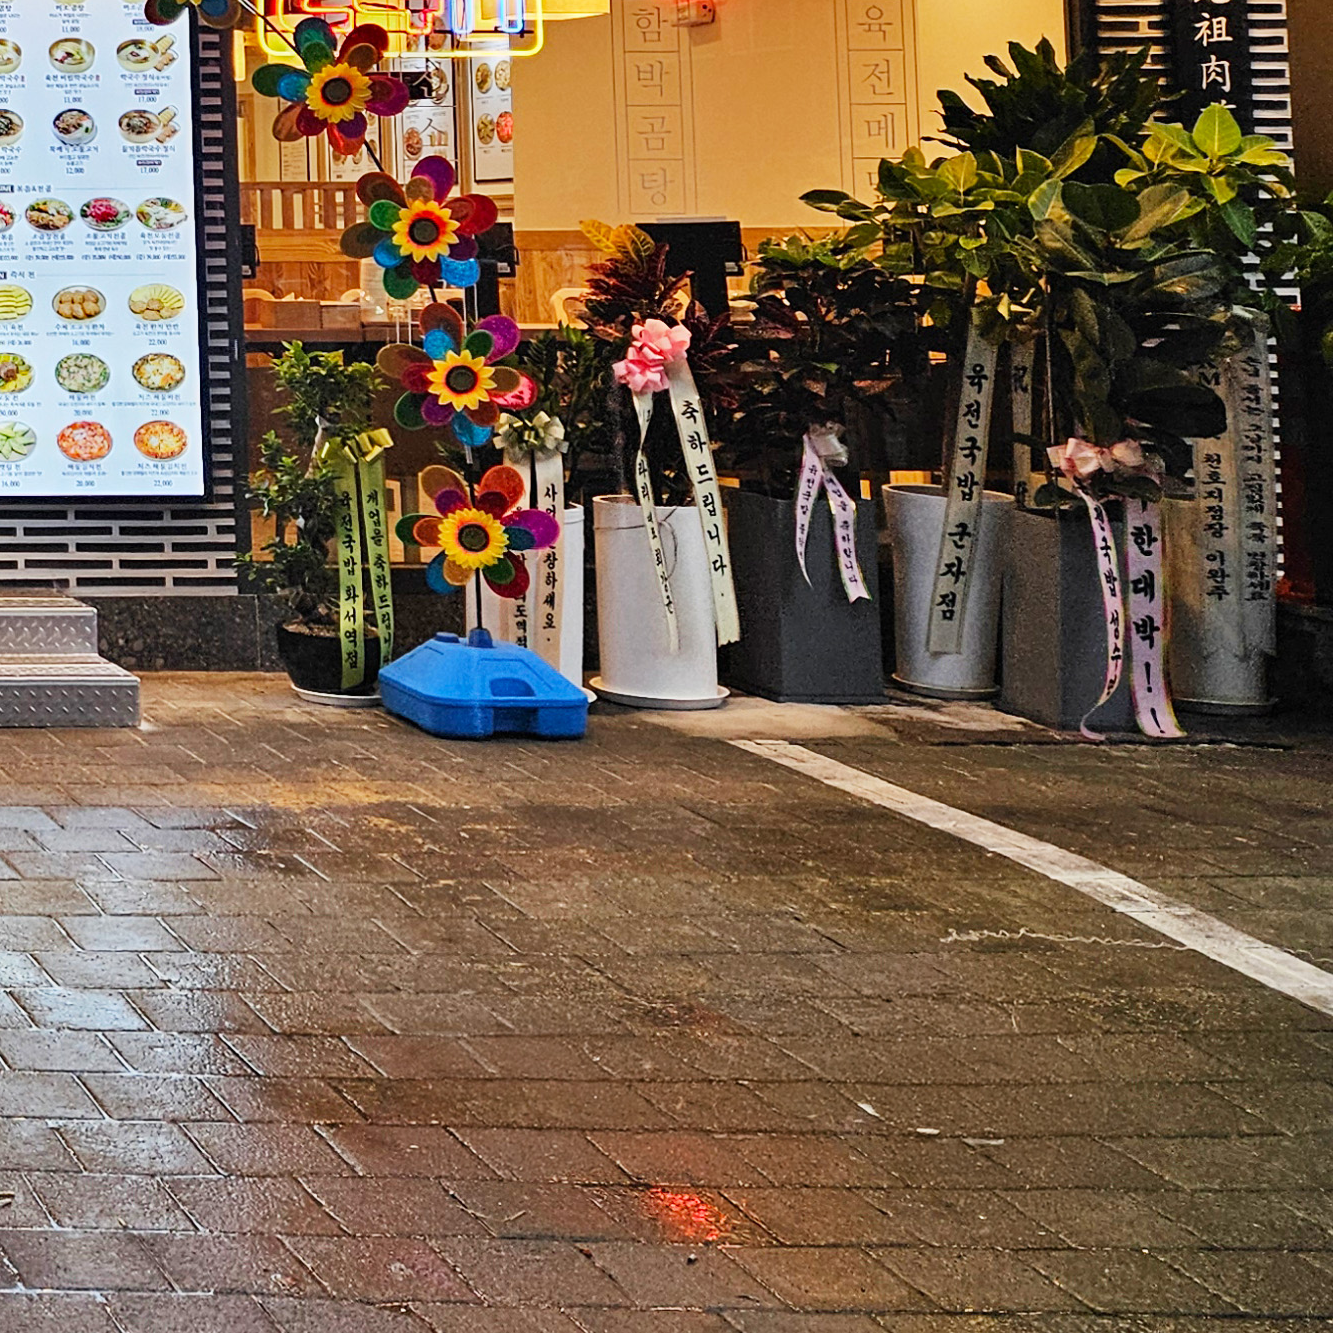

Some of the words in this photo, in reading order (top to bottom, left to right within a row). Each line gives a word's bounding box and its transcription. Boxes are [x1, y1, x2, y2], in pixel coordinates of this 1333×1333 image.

[632, 5, 676, 207] 함박곰탕
[955, 365, 989, 504] 육전국밥
[339, 490, 357, 576] 육전국밥
[366, 489, 385, 547] 개업을
[1090, 502, 1118, 598] 전국밥
[936, 522, 973, 622] 군자점
[343, 584, 360, 670] 화서역점
